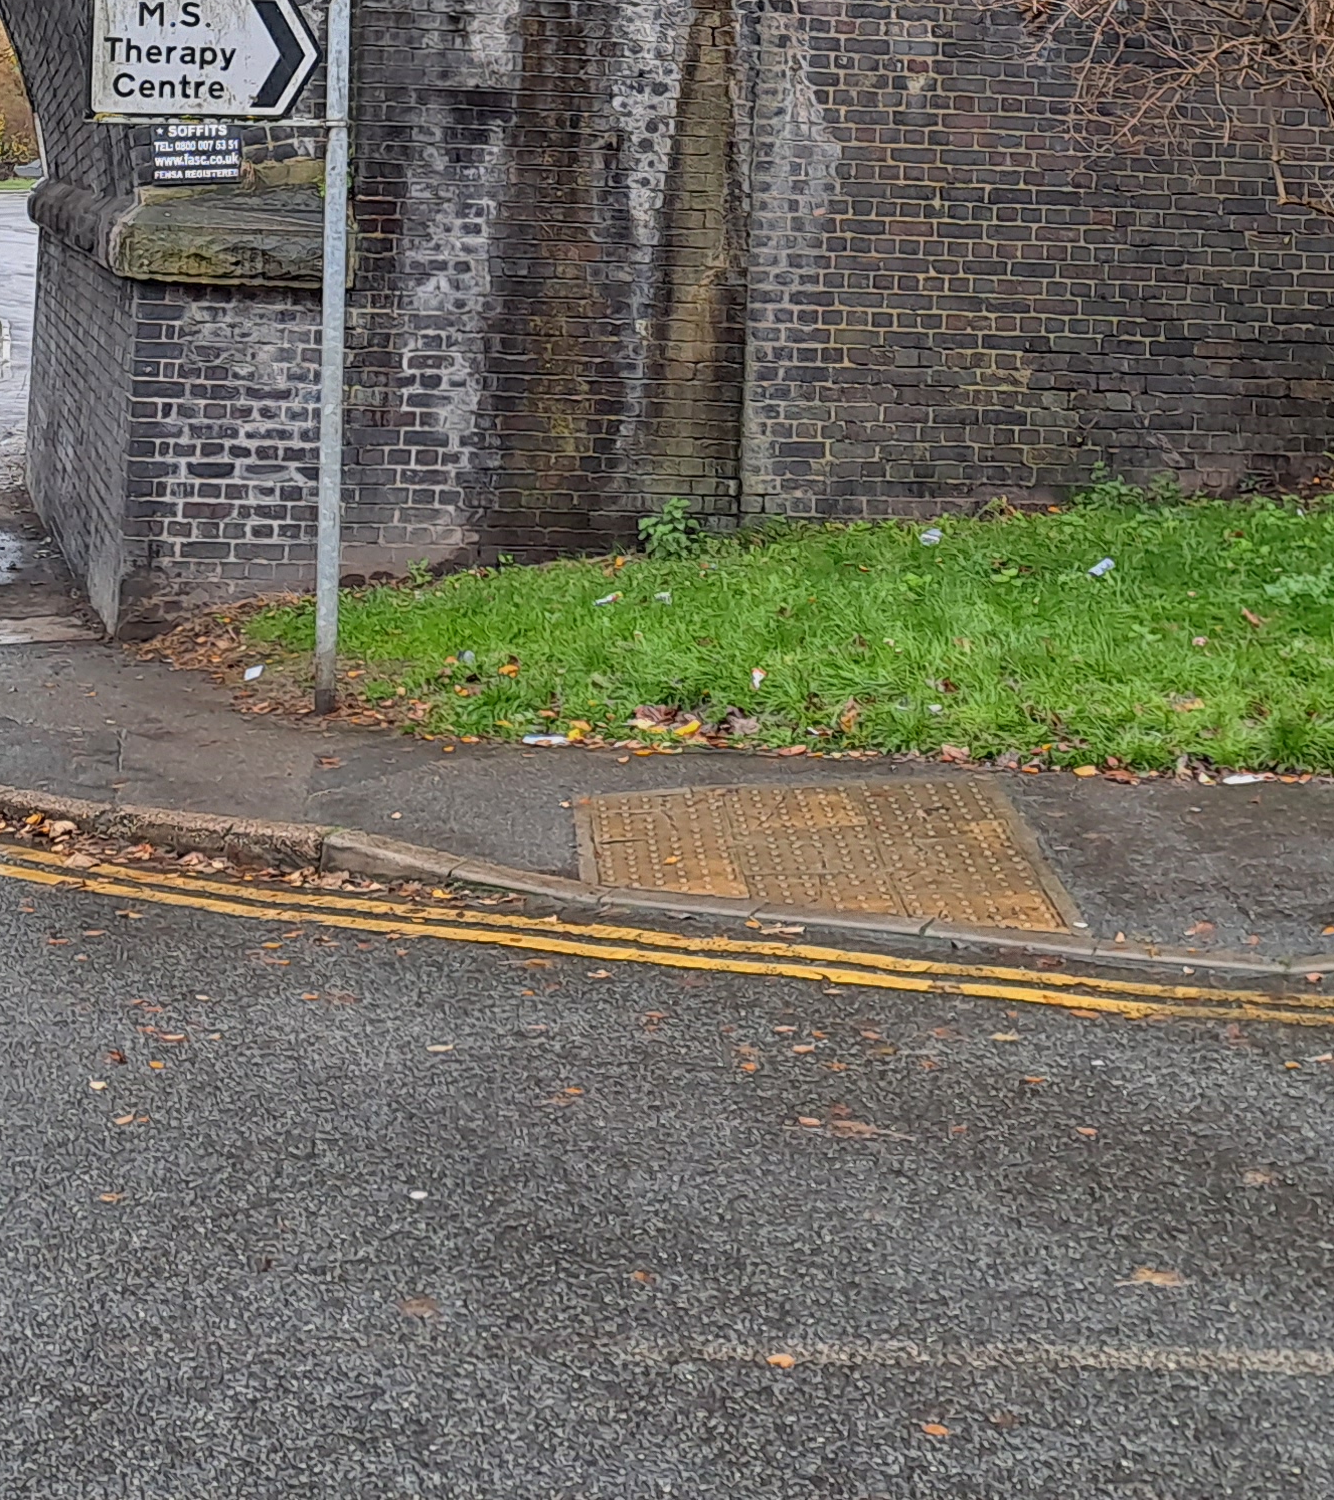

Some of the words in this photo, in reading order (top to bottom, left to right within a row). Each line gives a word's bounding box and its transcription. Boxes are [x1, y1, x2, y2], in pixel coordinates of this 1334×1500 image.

[139, 2, 211, 27] M.S.
[104, 36, 236, 71] Therapy
[113, 72, 224, 99] Centre
[168, 124, 228, 138] SOFFITS
[153, 141, 174, 152] TEL:
[175, 140, 196, 151] 0800
[197, 140, 214, 152] 007
[154, 152, 240, 167] www.fasc.co.uk
[154, 171, 183, 180] FENSA
